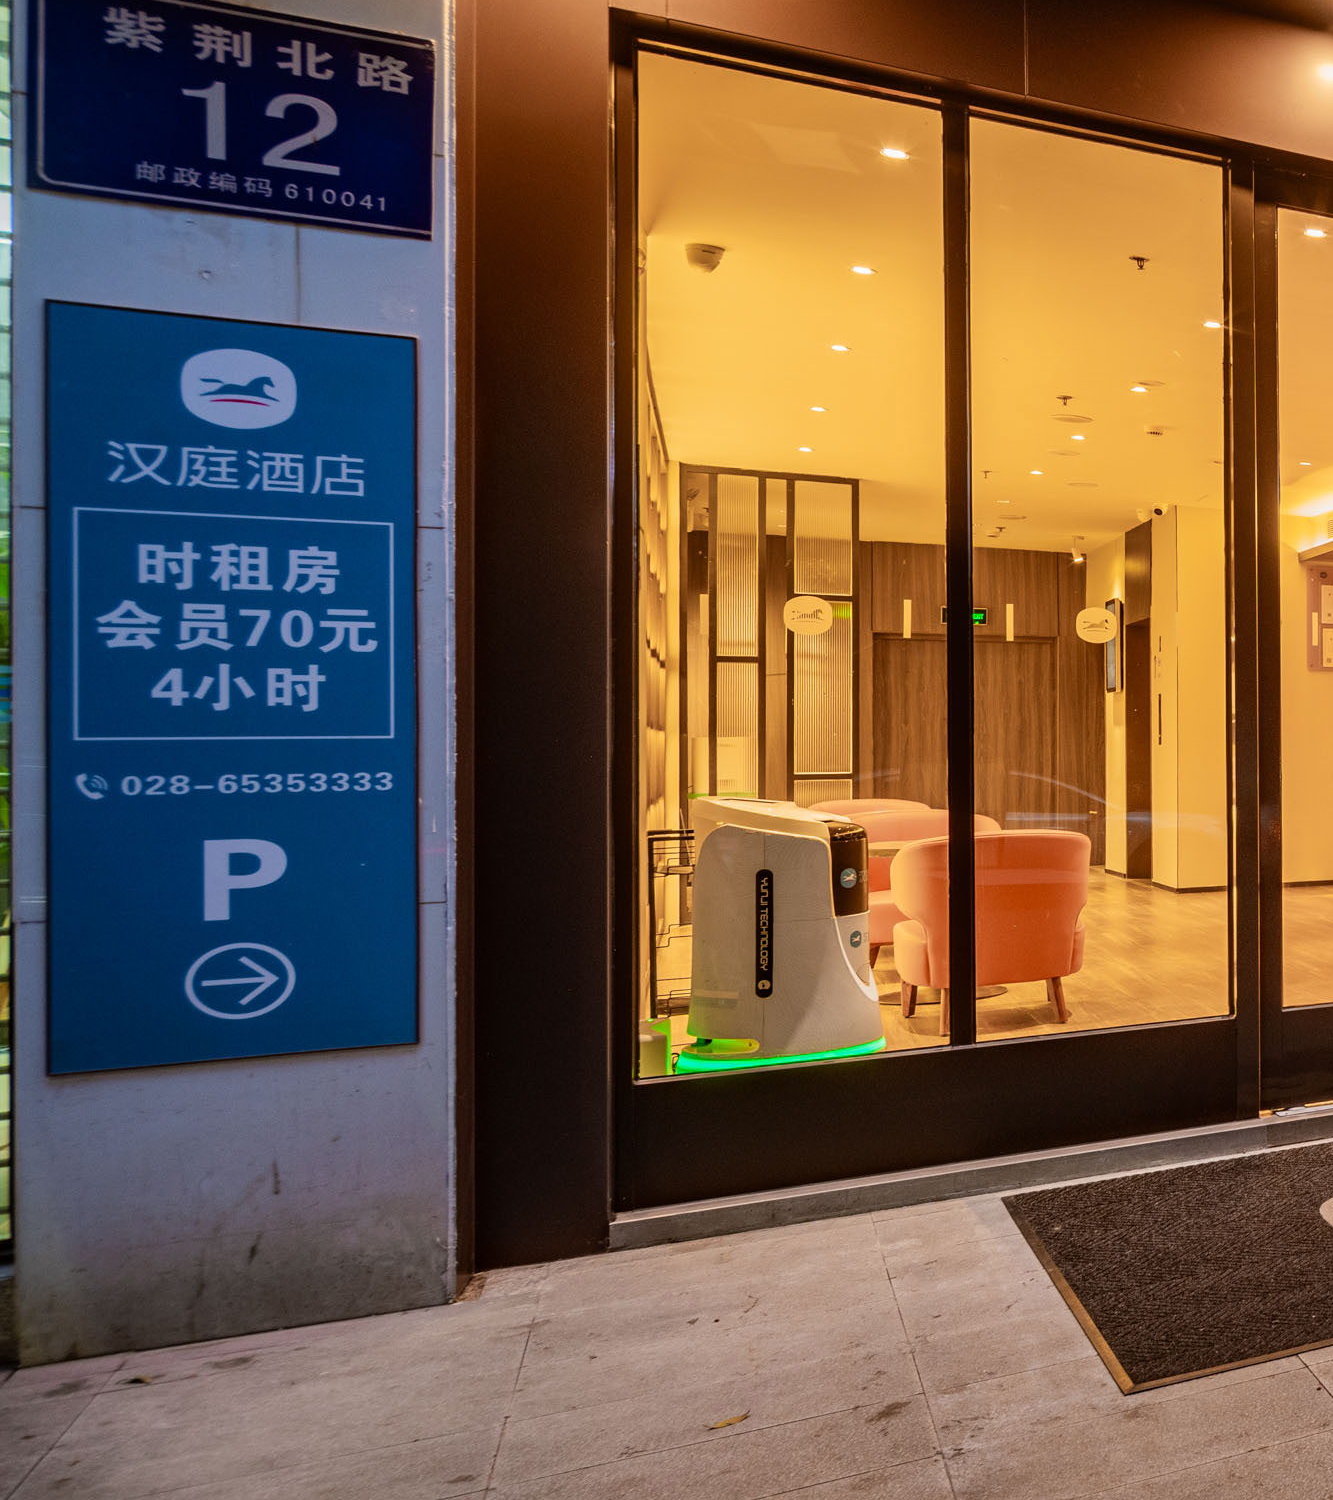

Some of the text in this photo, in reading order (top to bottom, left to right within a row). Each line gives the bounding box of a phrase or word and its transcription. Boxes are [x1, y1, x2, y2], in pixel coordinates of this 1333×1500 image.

[103, 7, 414, 95] 紫荆北路
[182, 81, 340, 176] 12
[135, 161, 388, 212] 邮政编码 610041
[106, 440, 365, 497] 汉庭酒店
[137, 542, 340, 595] 时租房
[96, 600, 379, 653] 会员70元
[151, 664, 327, 712] 4小时
[121, 772, 394, 796] 028-65353333
[203, 838, 288, 921] P
[759, 908, 769, 972] TECHNOLOGY
